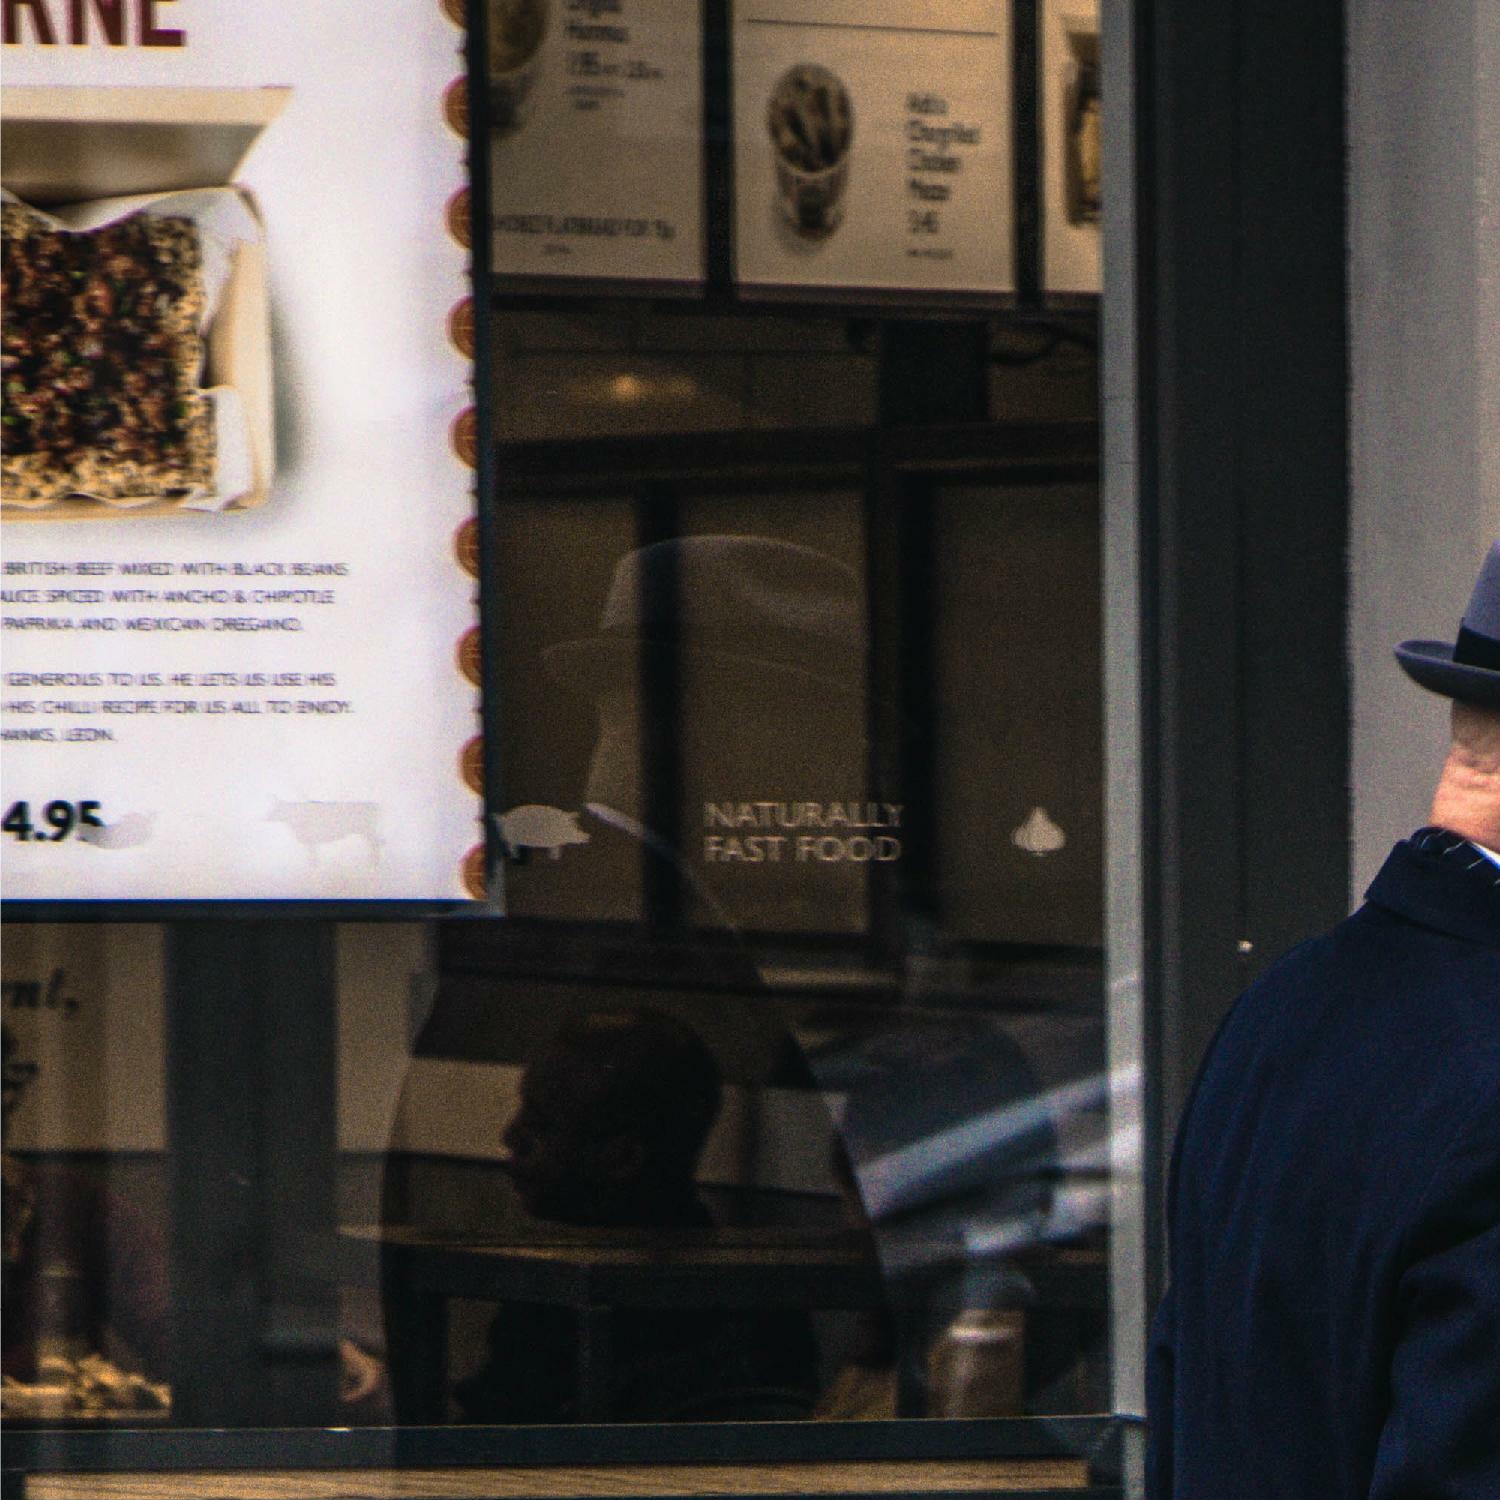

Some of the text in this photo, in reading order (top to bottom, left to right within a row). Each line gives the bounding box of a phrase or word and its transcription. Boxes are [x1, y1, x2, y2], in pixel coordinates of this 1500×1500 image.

[5, 562, 349, 576] BRITISH BEEF MIXED WITH BLACK BEANS
[46, 589, 103, 603] SPICED
[111, 589, 159, 603] WITH
[163, 589, 229, 603] ANCHO
[233, 589, 247, 603] &
[252, 589, 336, 603] CHIPOTLE
[3, 617, 75, 631] PAPRIKA
[80, 617, 119, 631] AND
[125, 617, 206, 631] MEXICAN
[7, 672, 102, 686] GENEROUS
[108, 672, 133, 686] TO
[170, 672, 194, 686] HE
[199, 672, 239, 686] LETS
[245, 672, 267, 686] US
[272, 672, 303, 686] USE
[308, 672, 337, 686] HIS
[40, 700, 97, 714] CHILLI
[102, 700, 161, 714] RECIPE
[163, 700, 199, 714] FOR
[204, 700, 227, 714] US
[231, 700, 262, 714] ALL
[265, 700, 291, 714] TO
[1, 800, 105, 841] 4.95
[703, 802, 903, 828] NATURALLY
[703, 836, 900, 861] FAST FOOD
